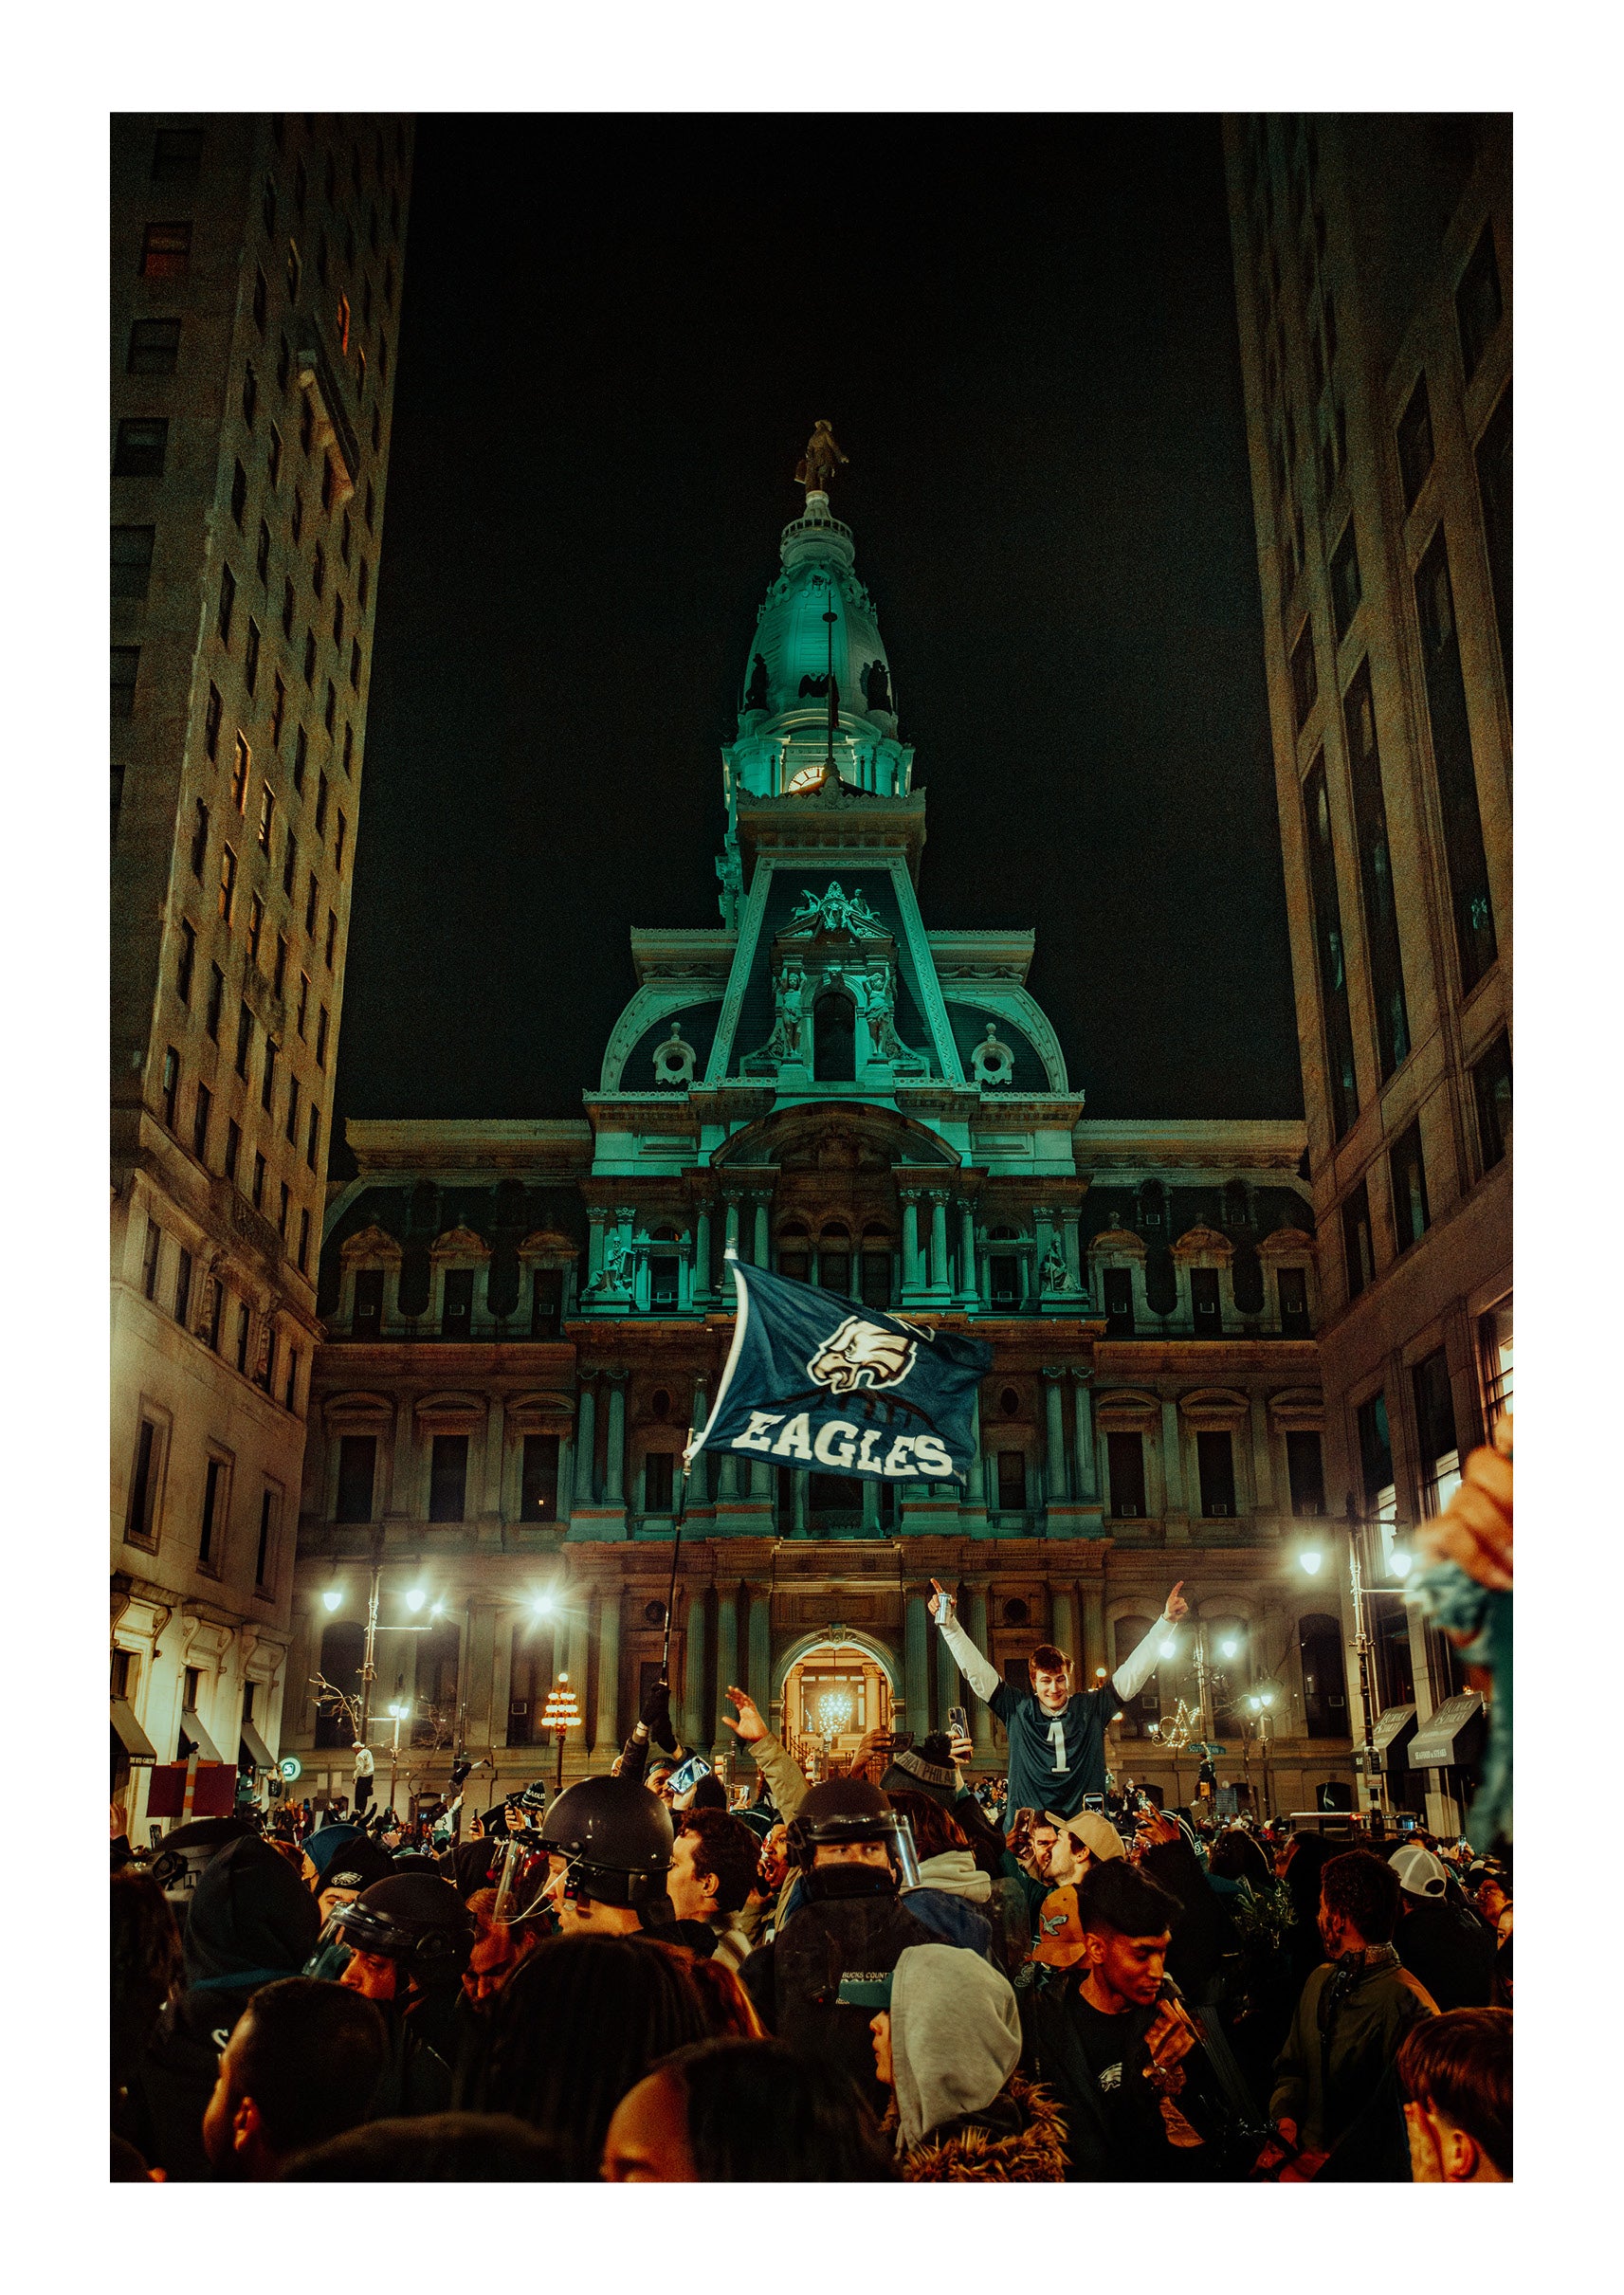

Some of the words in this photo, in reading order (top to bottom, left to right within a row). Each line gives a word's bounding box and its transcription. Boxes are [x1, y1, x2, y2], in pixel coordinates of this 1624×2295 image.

[731, 1411, 953, 1477] EAGLES
[1046, 1721, 1070, 1773] 1
[842, 1971, 864, 1979] BUCKS
